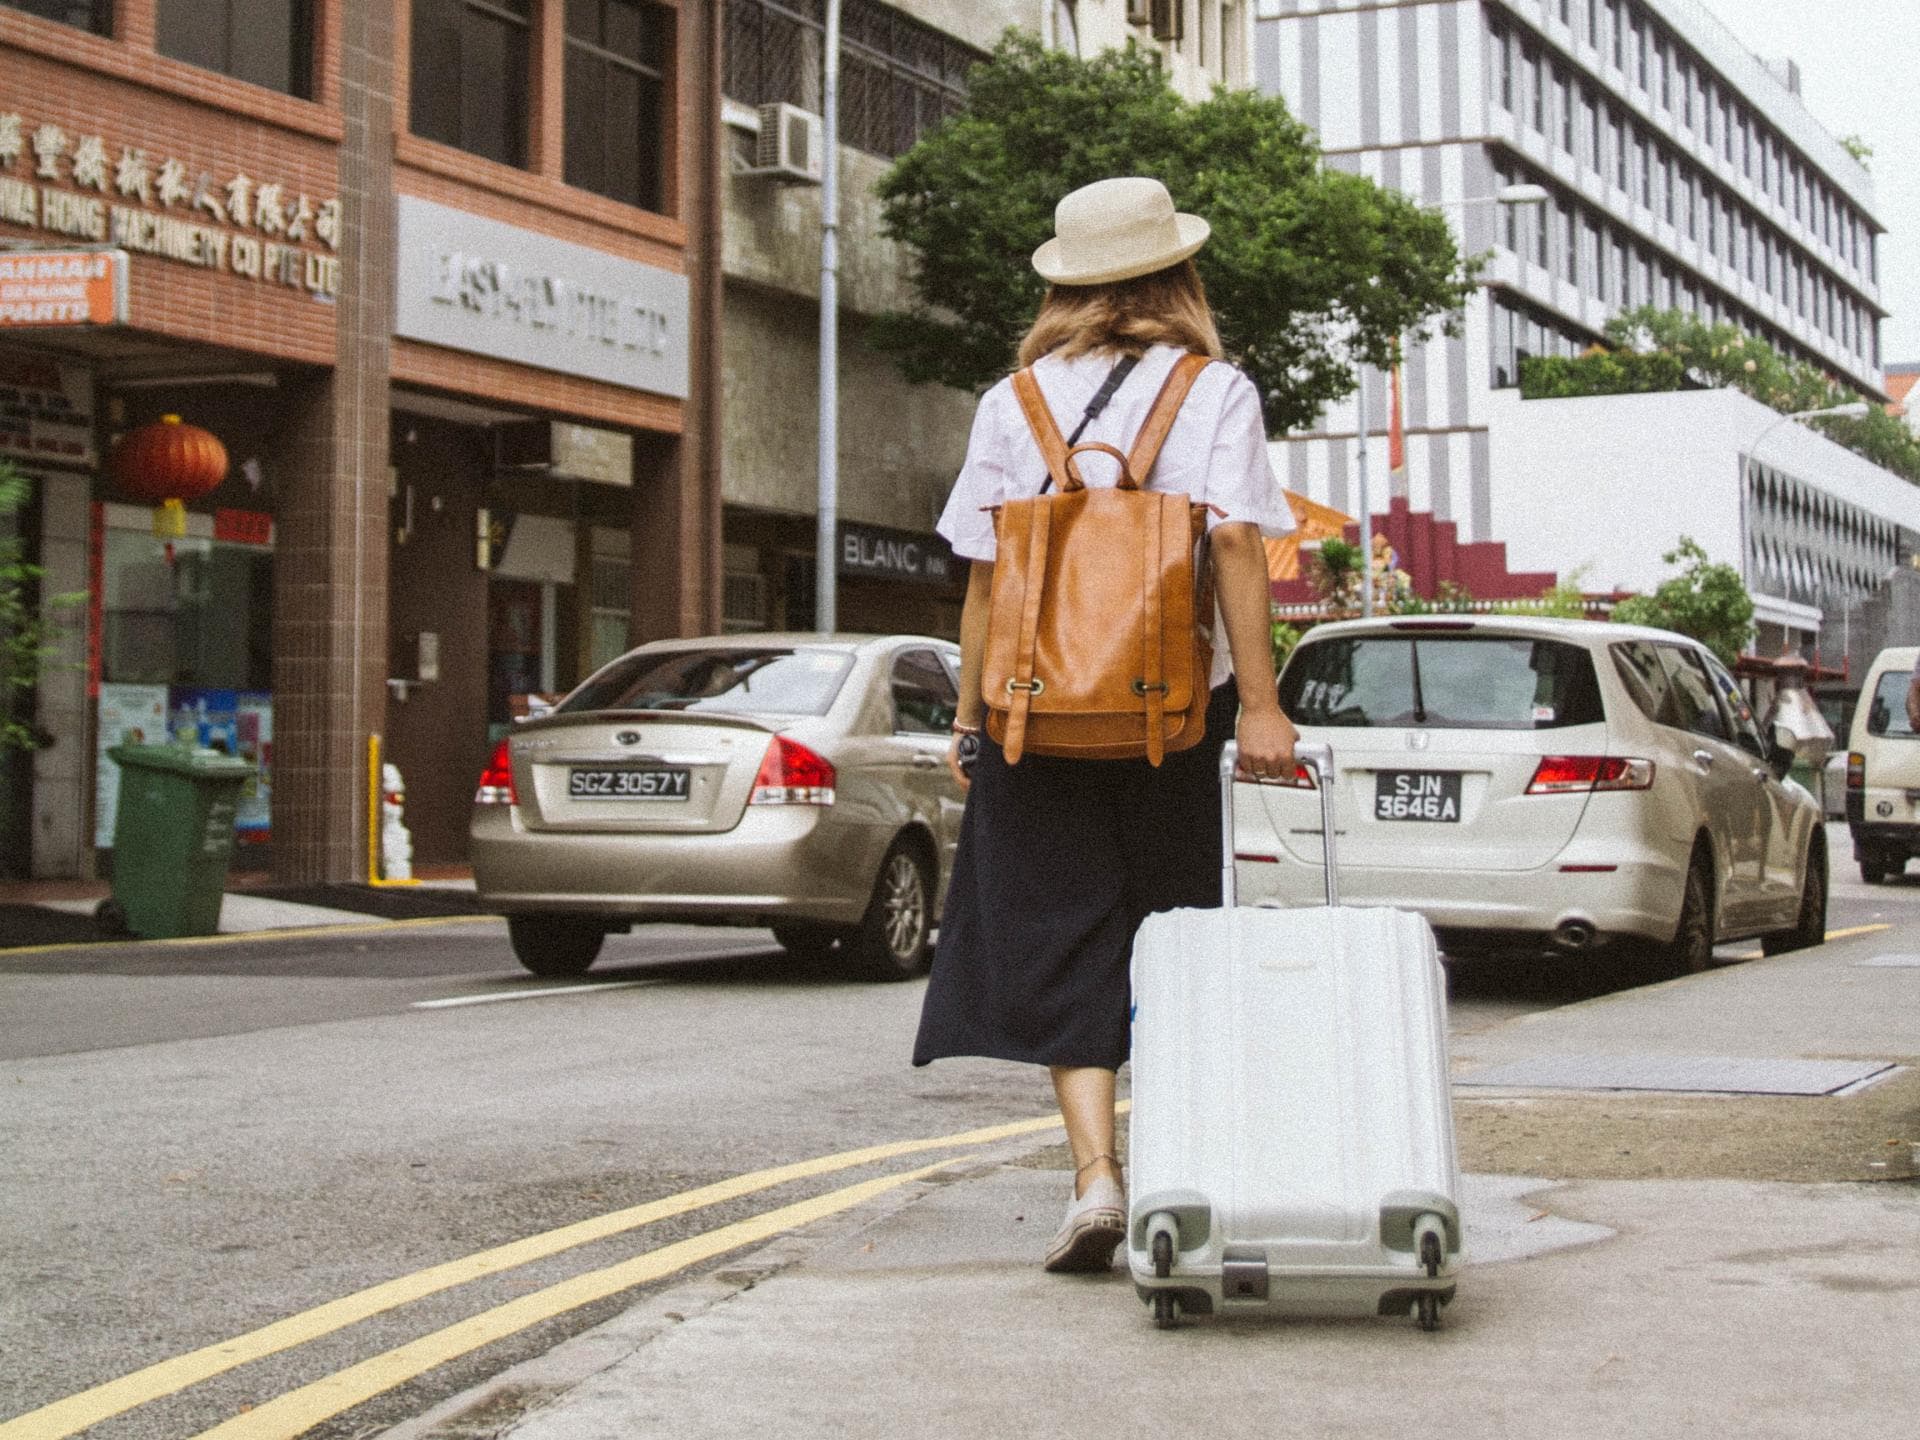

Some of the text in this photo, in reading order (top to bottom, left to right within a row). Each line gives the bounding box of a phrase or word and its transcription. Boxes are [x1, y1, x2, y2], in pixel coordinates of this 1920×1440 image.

[0, 175, 37, 228] WA
[43, 187, 105, 244] HONG
[110, 204, 229, 272] MACHINERY
[232, 235, 261, 280] CO
[264, 242, 301, 289] PTE
[844, 533, 918, 573] BLANC
[571, 772, 687, 793] SGZ 3057Y
[1395, 774, 1441, 796] SJN
[1378, 795, 1456, 819] 3646A
